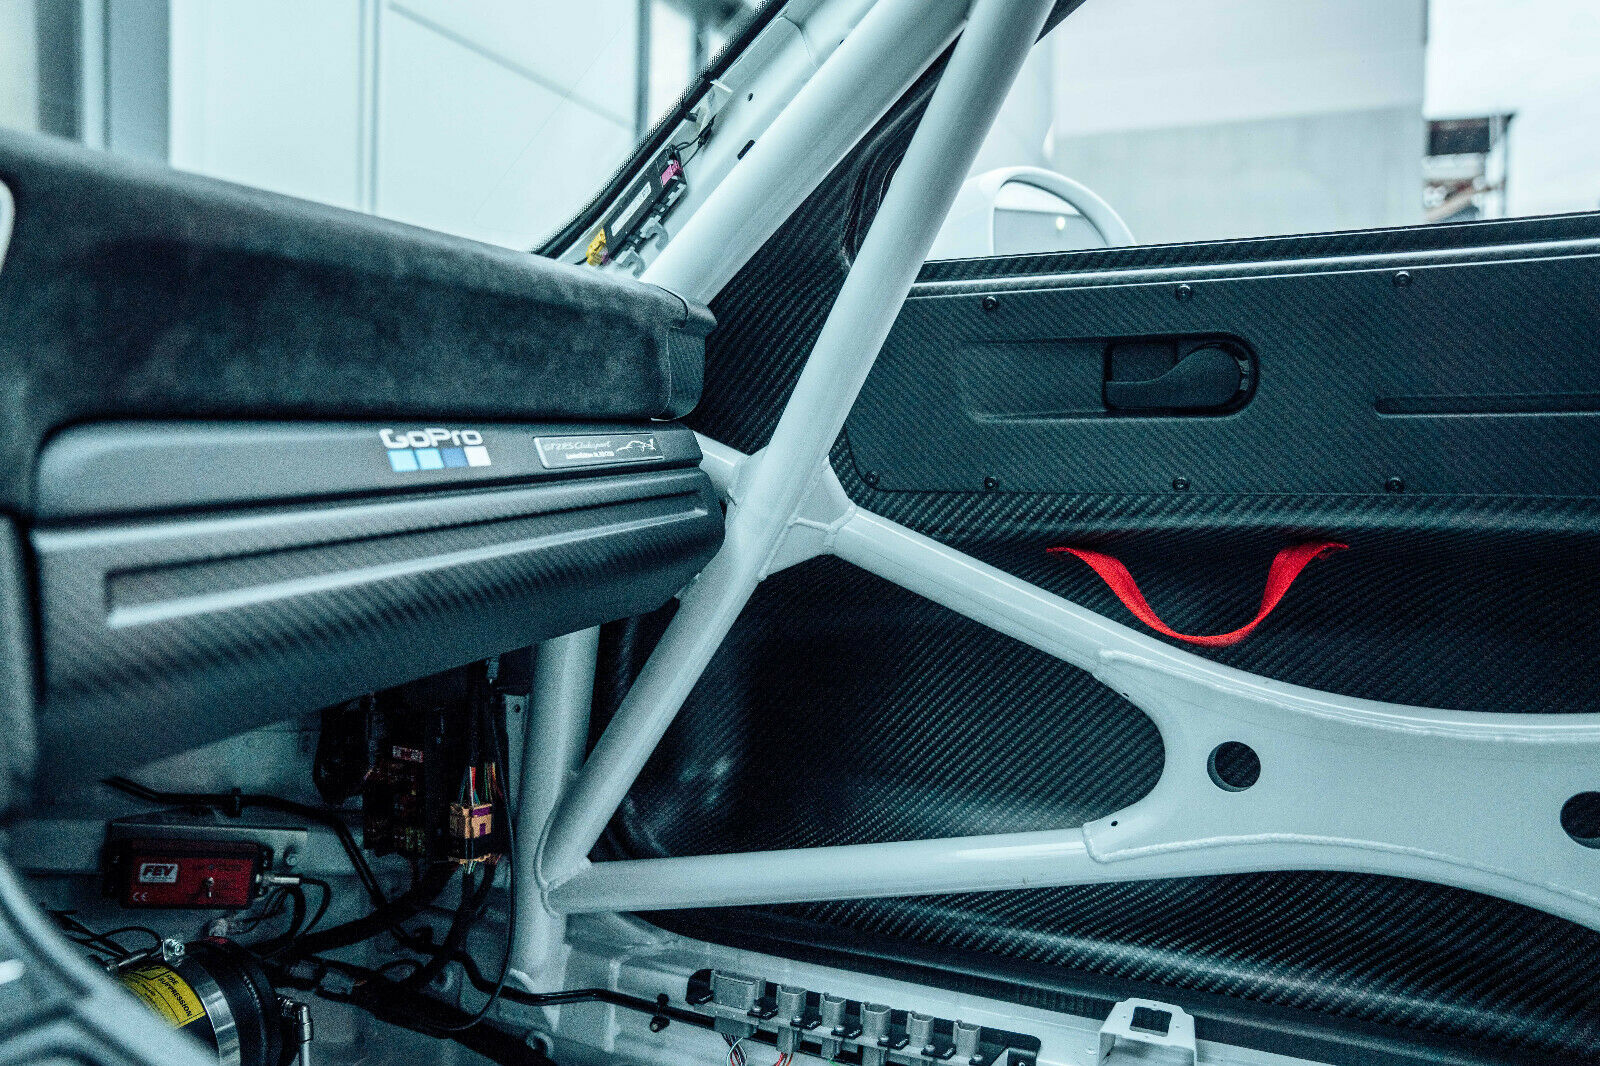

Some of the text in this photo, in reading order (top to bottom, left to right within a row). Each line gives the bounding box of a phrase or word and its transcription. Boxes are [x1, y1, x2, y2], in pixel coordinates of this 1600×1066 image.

[379, 428, 483, 449] GoPro
[143, 865, 175, 876] FEV
[165, 974, 179, 985] FIRE
[158, 977, 193, 1016] SUPPRESSION
